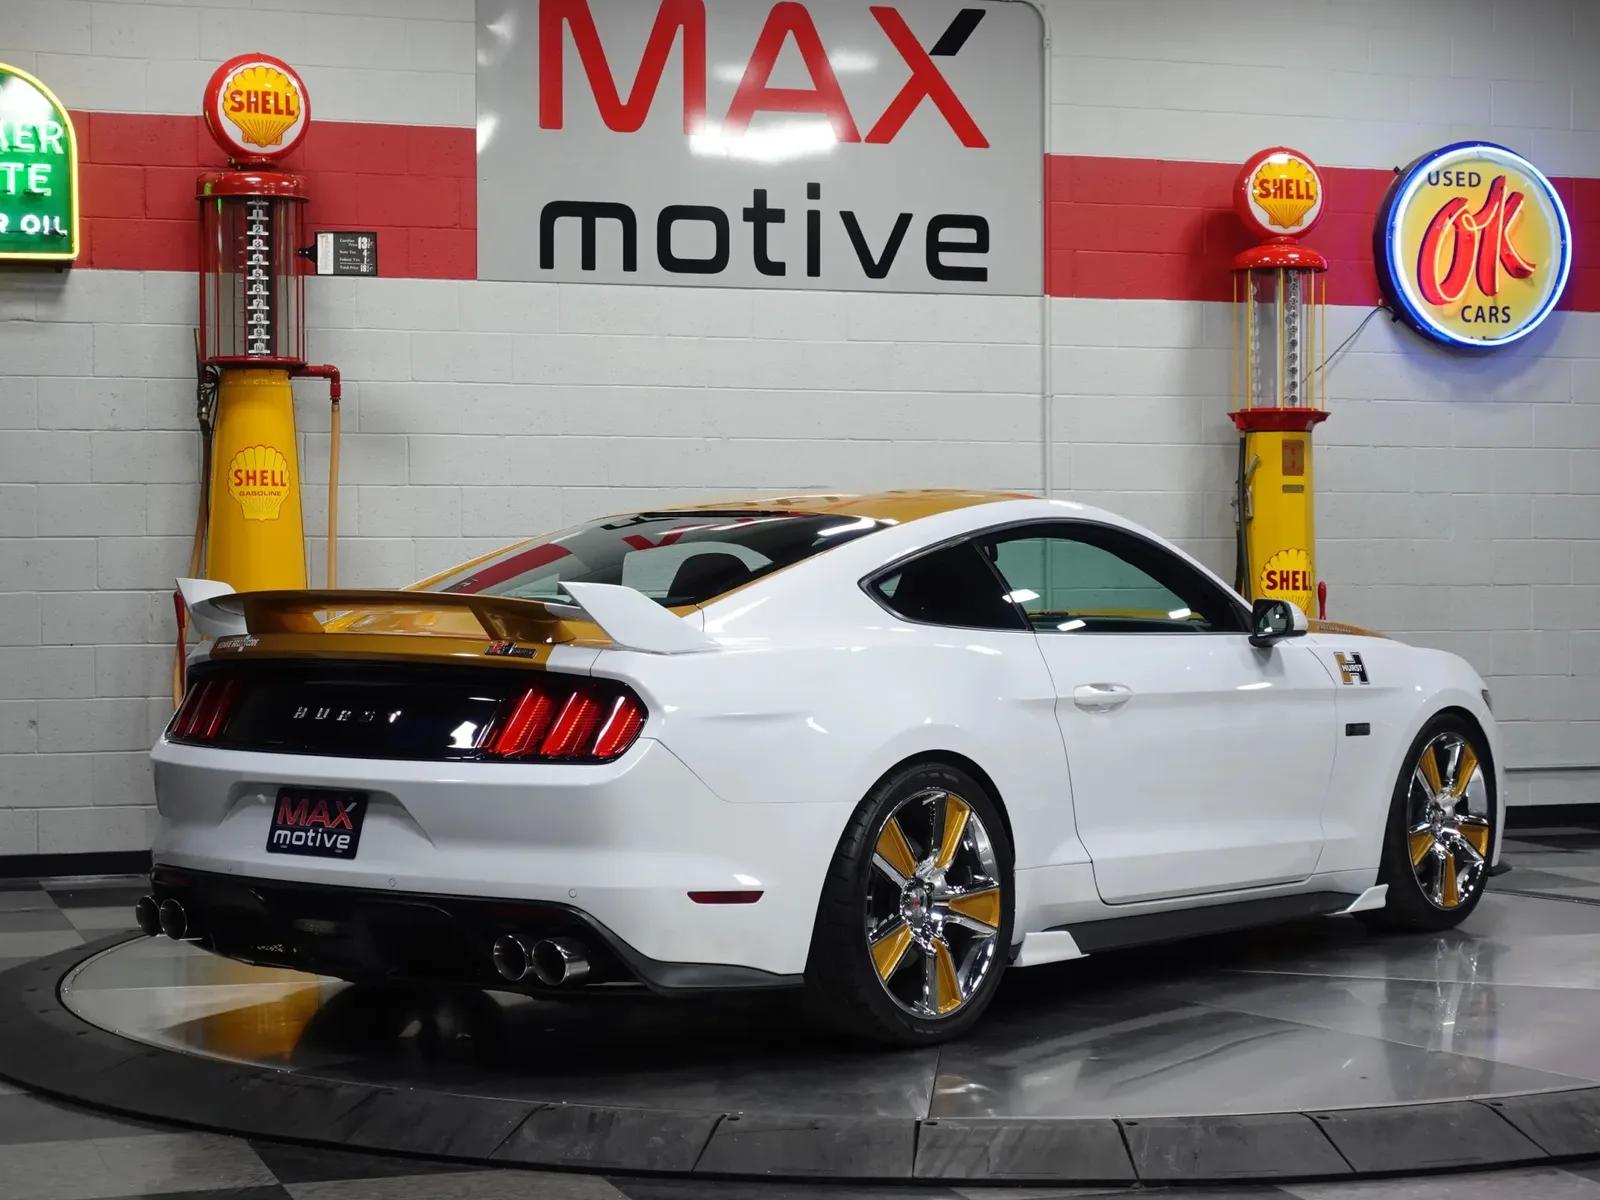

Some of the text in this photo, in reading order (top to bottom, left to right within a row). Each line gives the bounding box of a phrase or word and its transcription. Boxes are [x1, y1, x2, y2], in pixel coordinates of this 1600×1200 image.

[539, 0, 990, 148] MAX
[230, 89, 295, 116] SHELL
[1258, 178, 1314, 200] SHELL
[1427, 170, 1482, 188] USED
[20, 213, 68, 237] OIL
[540, 182, 990, 282] motive
[1417, 175, 1537, 306] OK
[1460, 305, 1512, 324] CARS
[233, 468, 287, 487] SHELL
[1265, 569, 1313, 592] SHELL
[1341, 664, 1363, 673] HURST
[277, 796, 358, 830] MAX
[273, 827, 351, 850] motive
